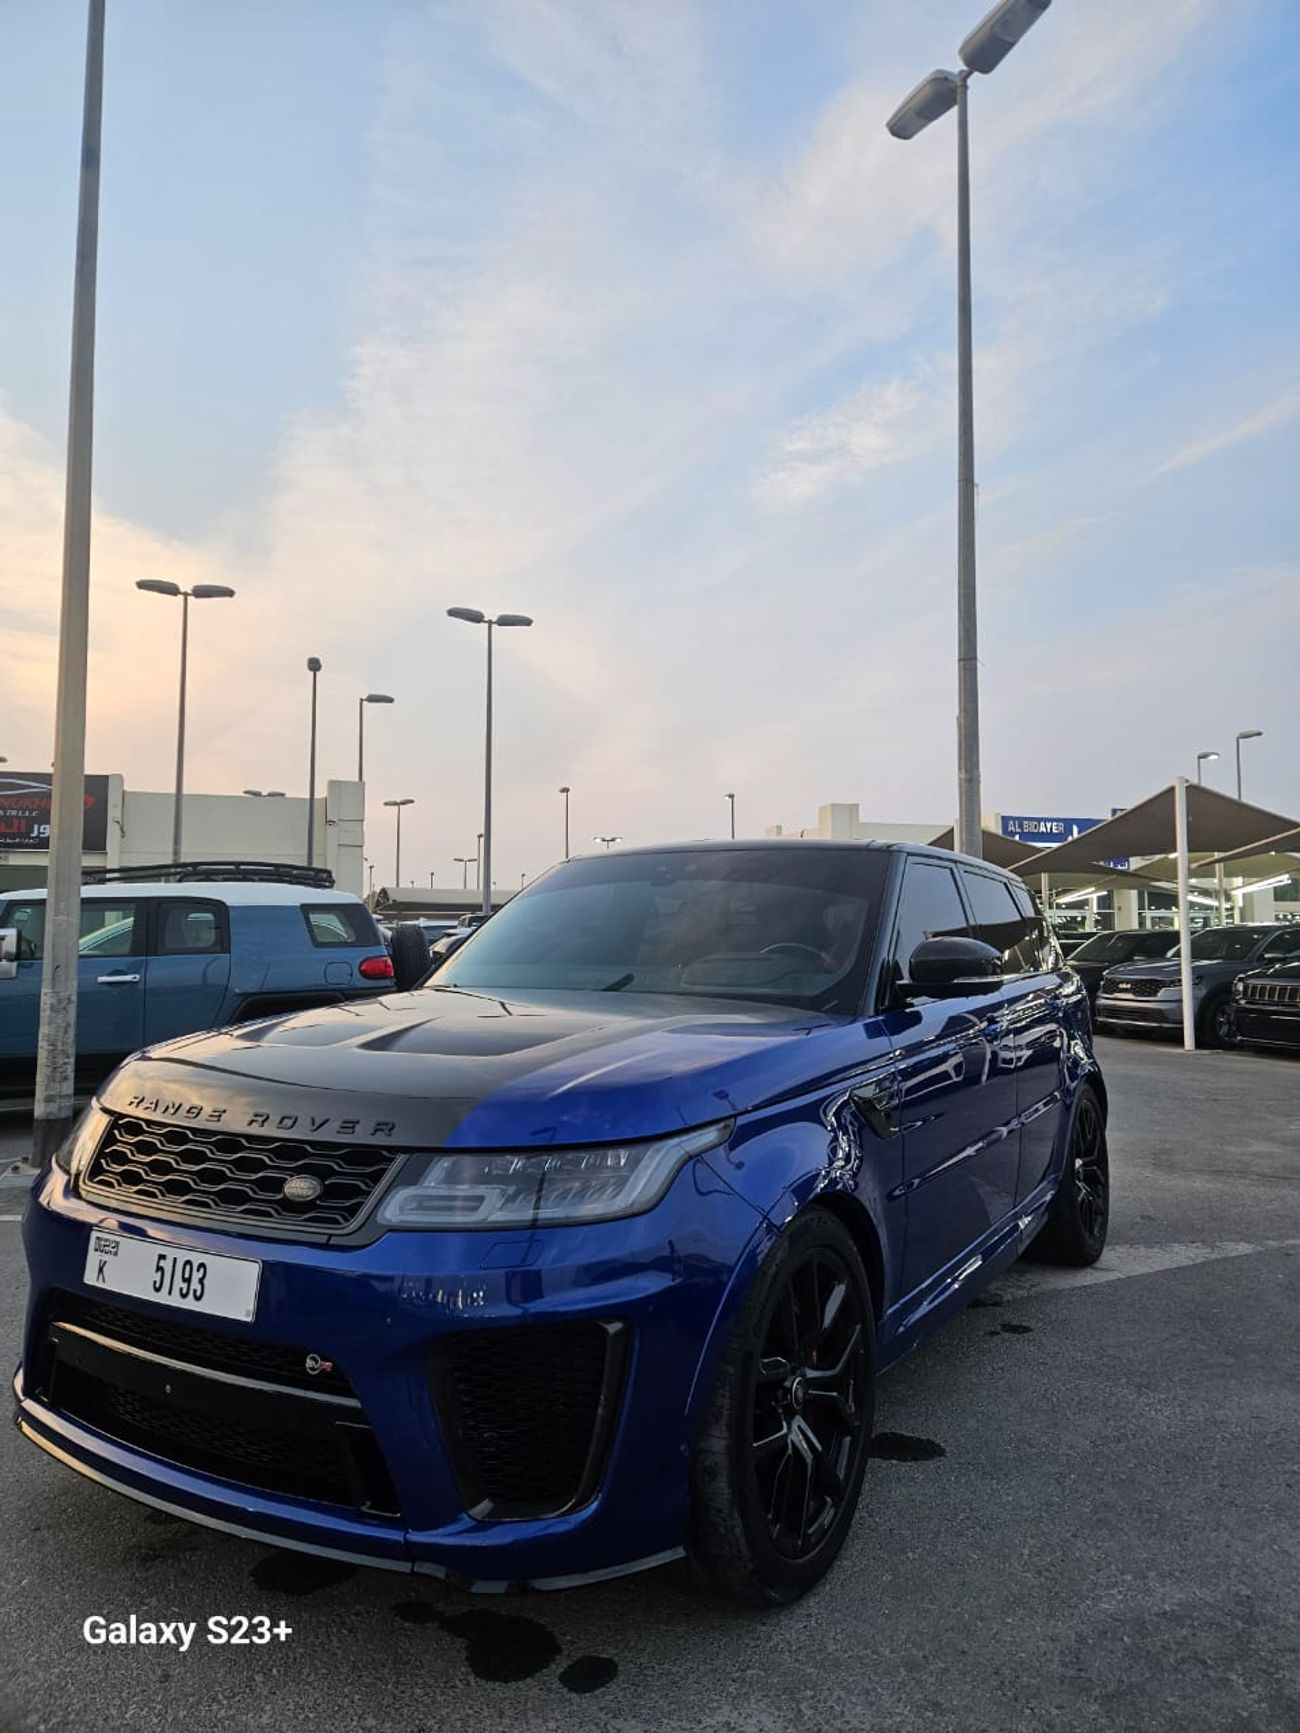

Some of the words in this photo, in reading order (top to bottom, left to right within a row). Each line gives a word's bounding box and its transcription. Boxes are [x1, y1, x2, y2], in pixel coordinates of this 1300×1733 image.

[1007, 820, 1021, 833] AL
[1023, 820, 1065, 834] BIDAYER
[128, 1095, 226, 1122] RANGE
[247, 1112, 396, 1136] ROVER
[95, 1258, 108, 1284] K
[152, 1252, 209, 1302] 5193
